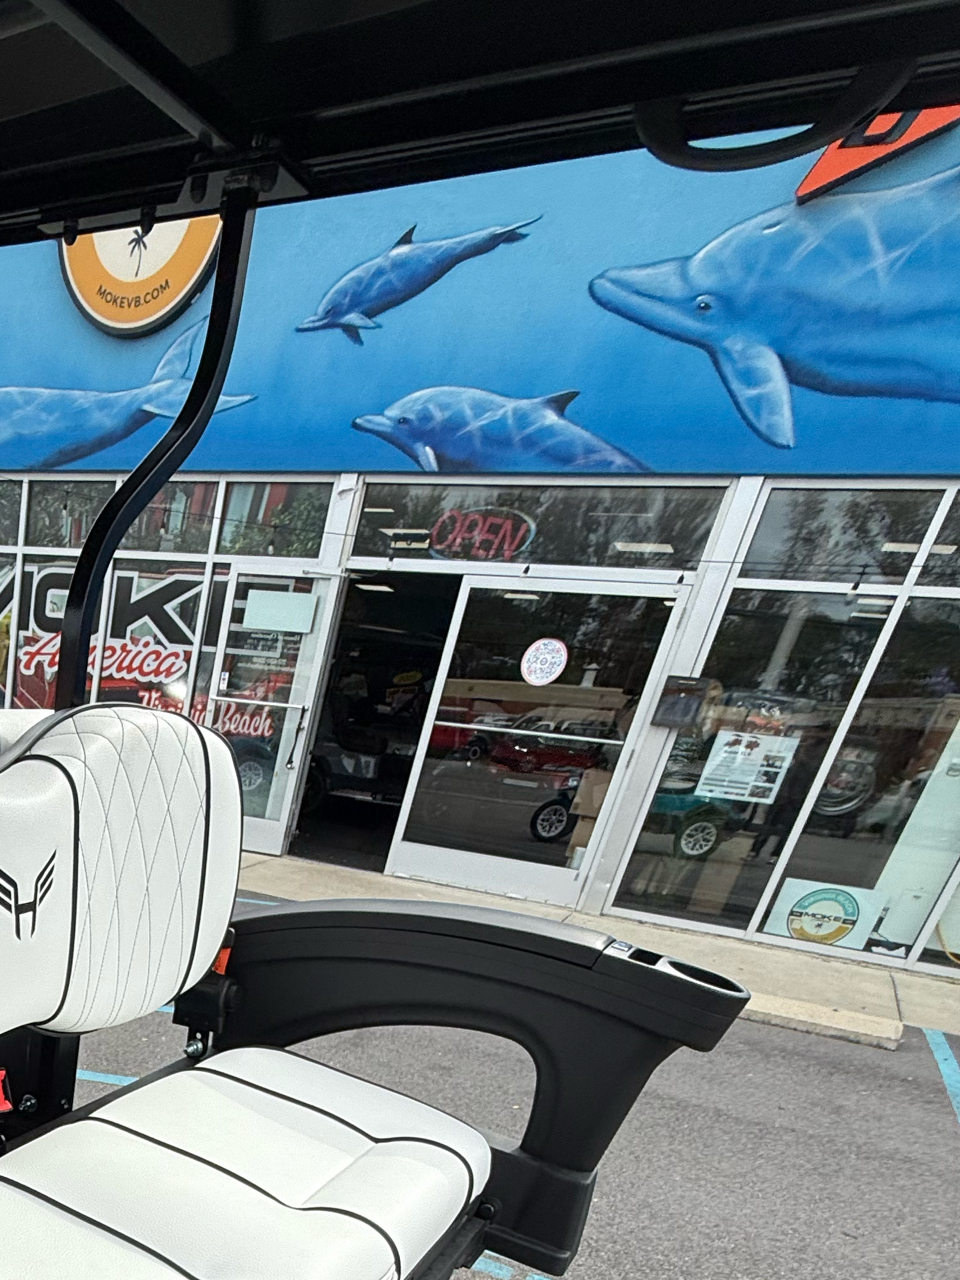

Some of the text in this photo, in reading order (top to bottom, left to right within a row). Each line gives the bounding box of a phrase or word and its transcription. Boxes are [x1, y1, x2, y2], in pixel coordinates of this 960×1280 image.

[97, 279, 170, 309] MOKEVB.COM
[431, 509, 529, 561] OPEN
[21, 630, 184, 680] Aerica
[213, 701, 273, 737] Beach
